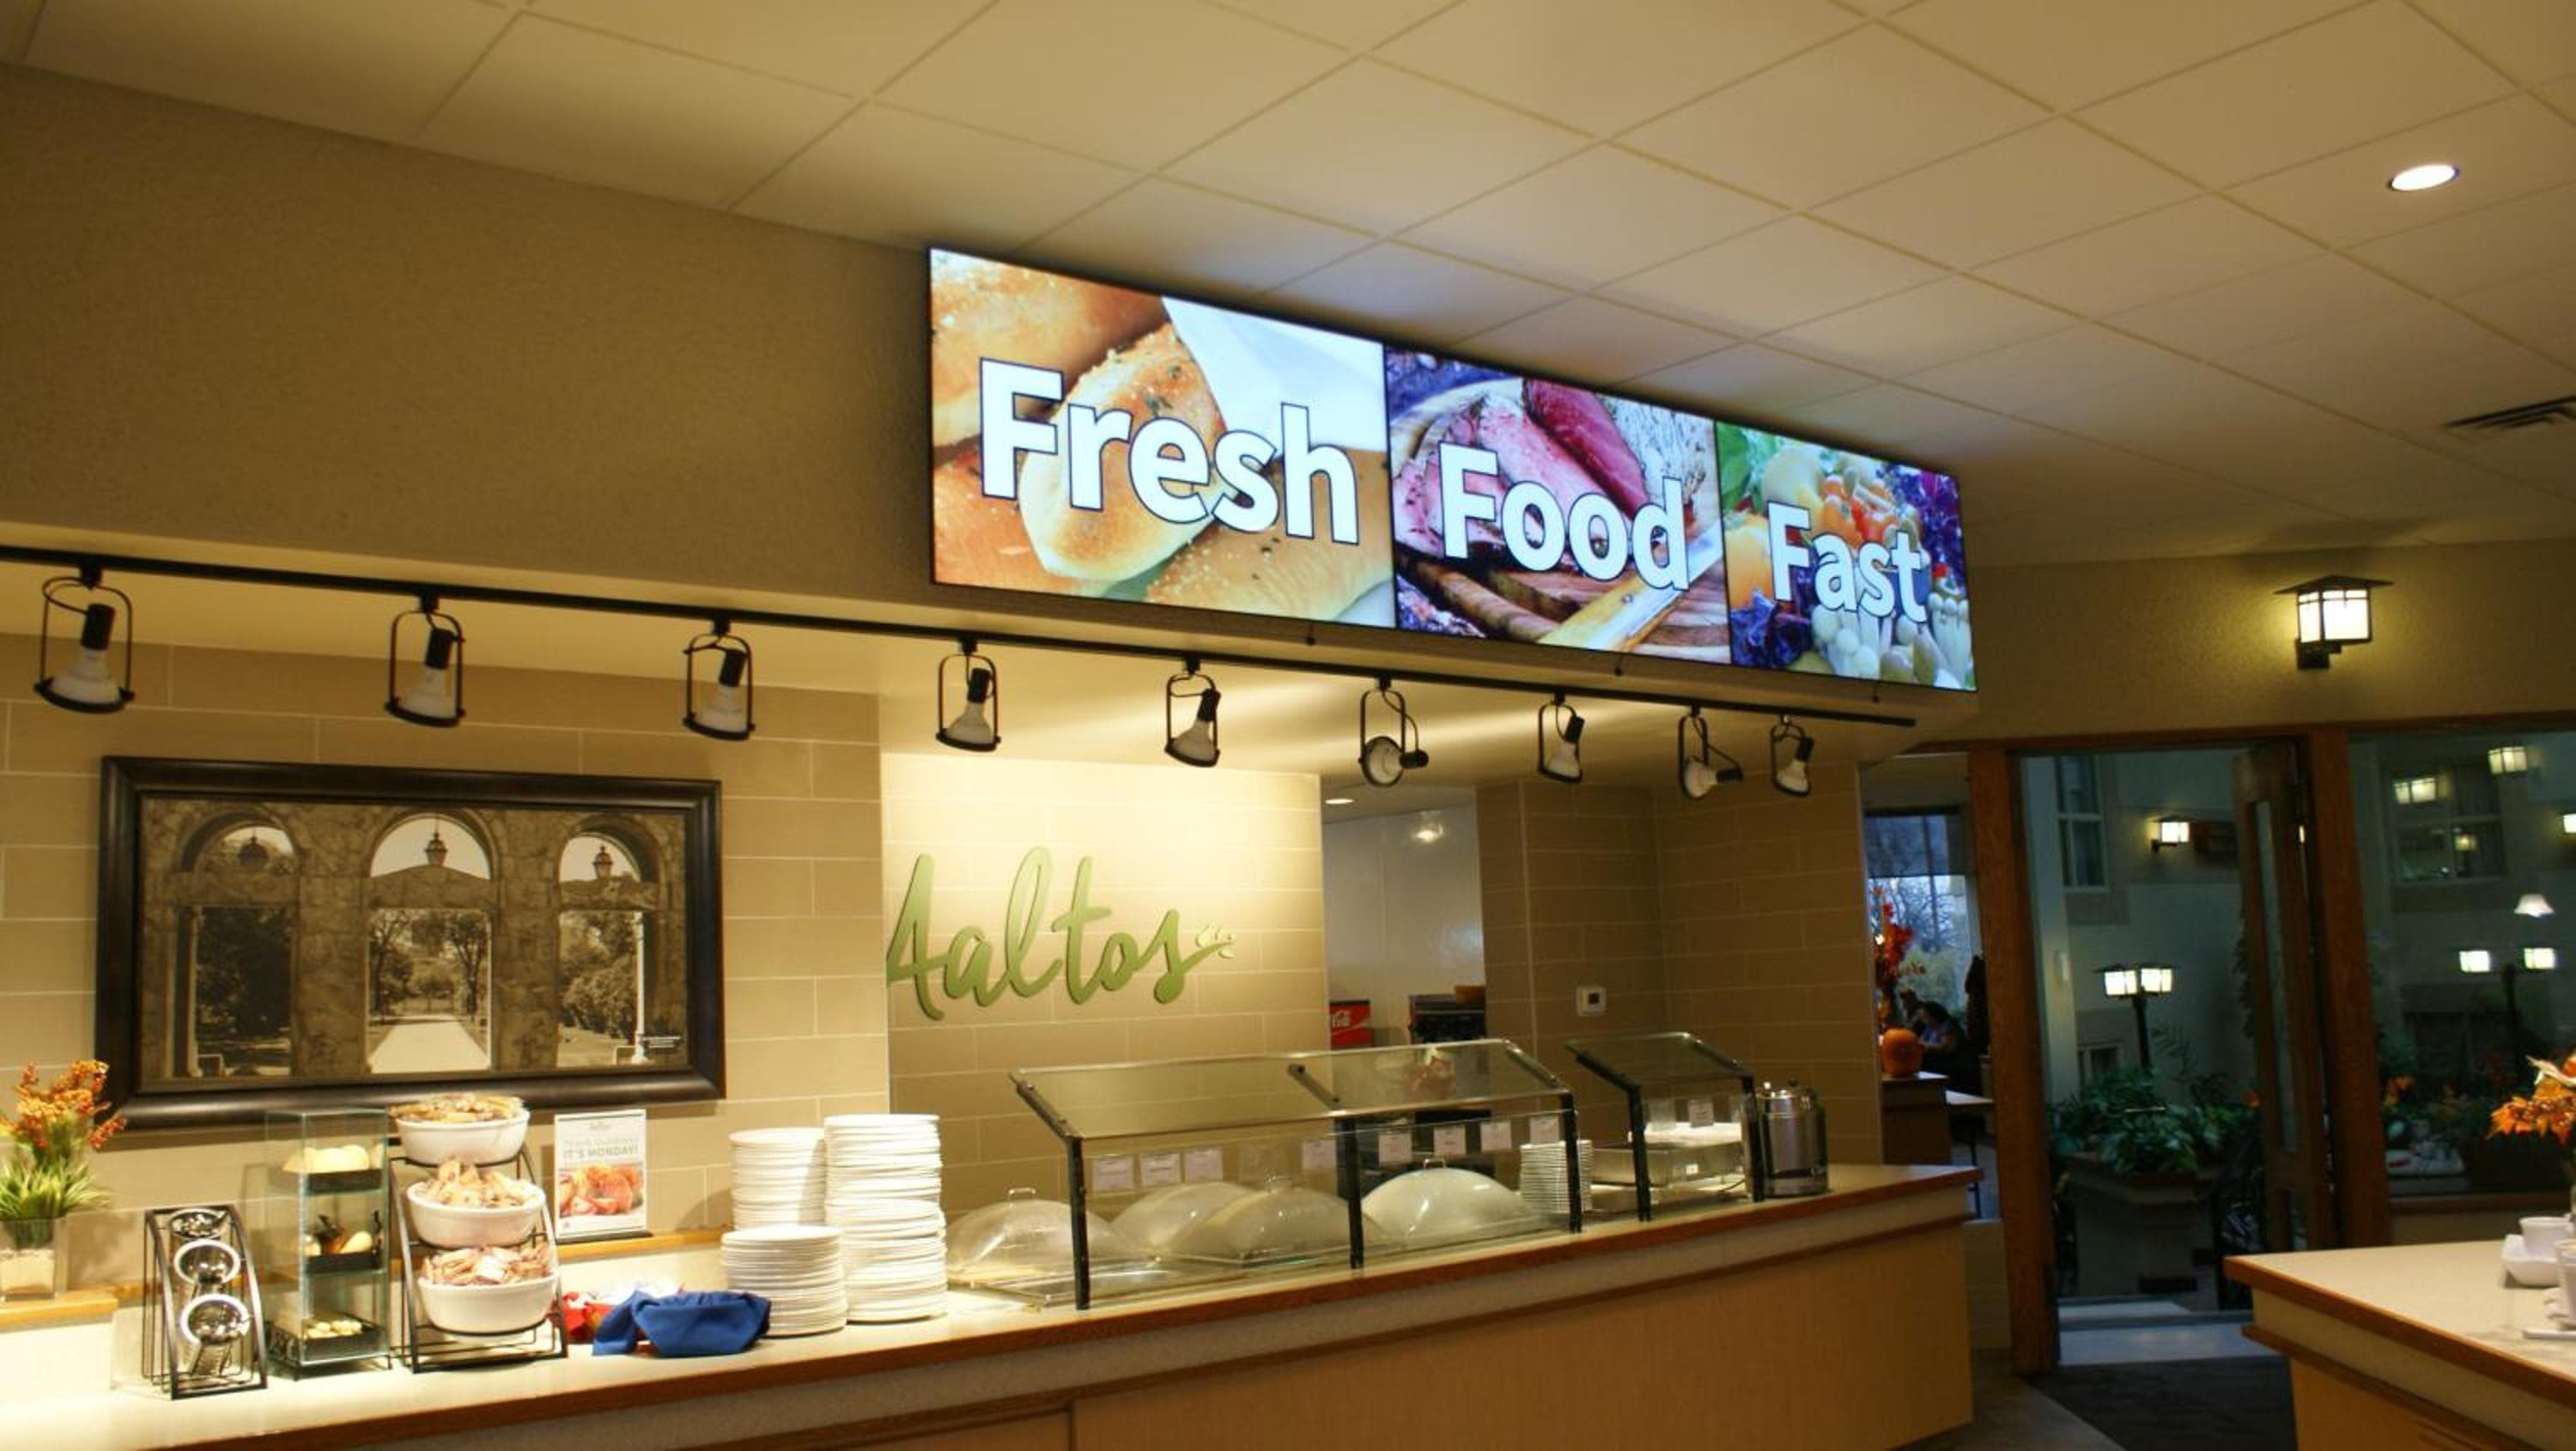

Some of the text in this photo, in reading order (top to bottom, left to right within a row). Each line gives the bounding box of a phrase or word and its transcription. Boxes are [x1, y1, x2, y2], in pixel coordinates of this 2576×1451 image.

[980, 357, 1928, 623] Fresh Food Fast
